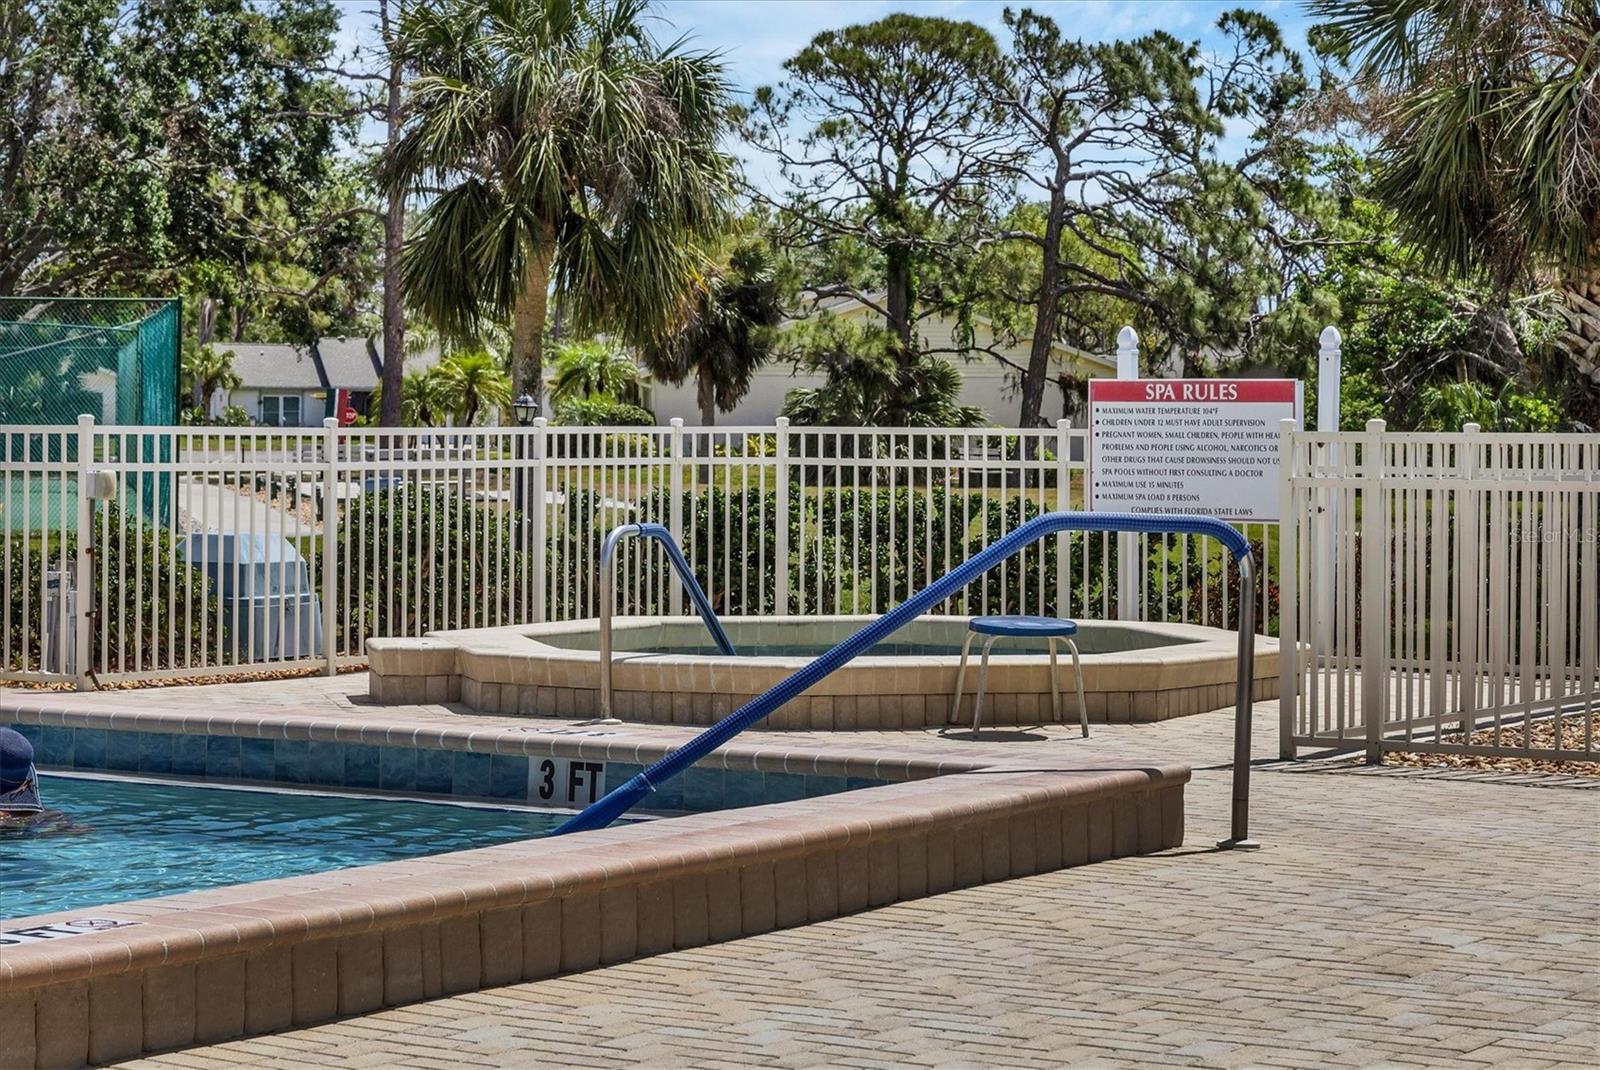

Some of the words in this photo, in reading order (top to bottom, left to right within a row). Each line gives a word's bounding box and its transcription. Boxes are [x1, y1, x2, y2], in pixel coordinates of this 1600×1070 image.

[1145, 383, 1176, 400] SPA
[1183, 383, 1238, 400] RULES
[1197, 444, 1229, 452] ALCOHOL,
[1230, 444, 1267, 452] NARCOTICS
[1269, 444, 1279, 452] OR
[1136, 468, 1167, 476] WITHOUT
[1169, 468, 1185, 476] FIRST
[1228, 469, 1233, 477] A
[1235, 469, 1263, 477] DOCTOR
[1131, 506, 1163, 514] COMPLIES
[1184, 507, 1213, 515] FLORIDA
[539, 759, 555, 800] 3
[568, 761, 603, 803] FT
[2, 925, 84, 939] FT
